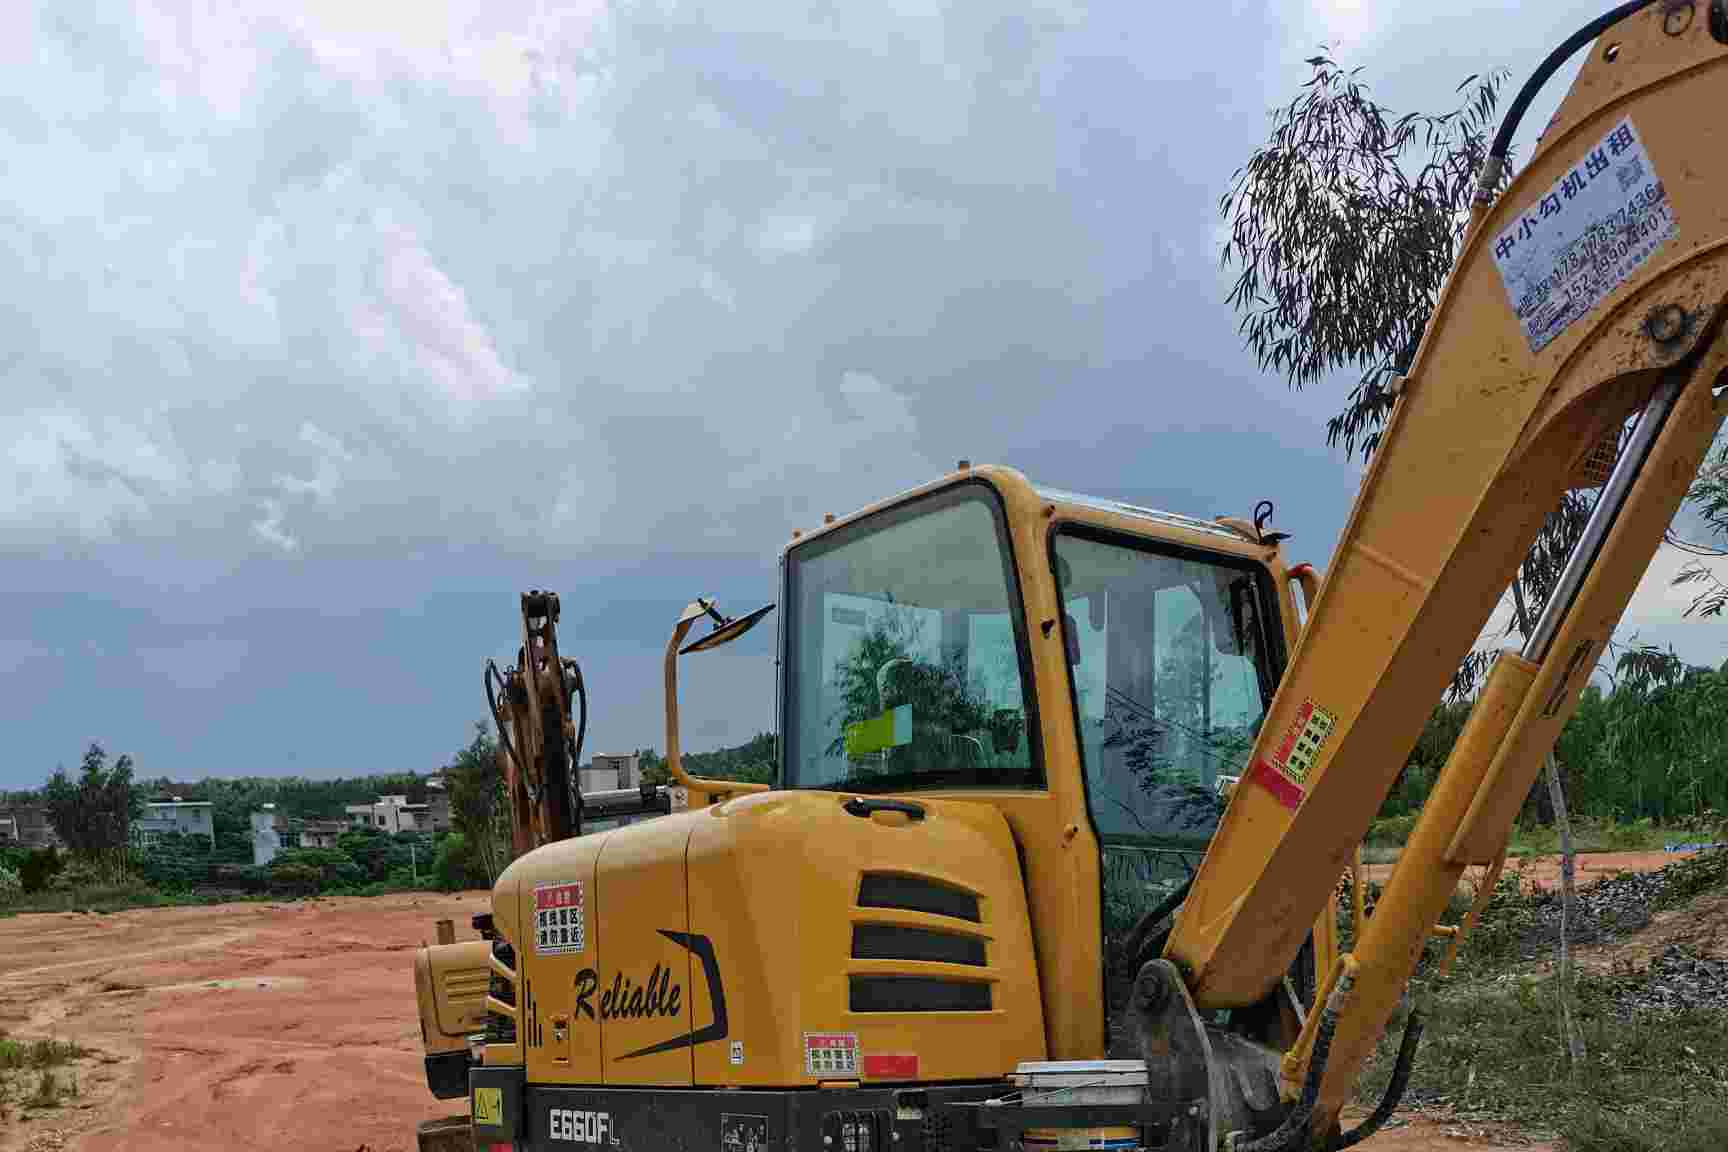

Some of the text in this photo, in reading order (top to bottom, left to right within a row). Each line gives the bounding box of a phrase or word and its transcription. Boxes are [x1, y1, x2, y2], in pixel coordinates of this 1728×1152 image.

[1495, 123, 1635, 260] 中小勾机出租
[574, 961, 680, 1020] Reliable
